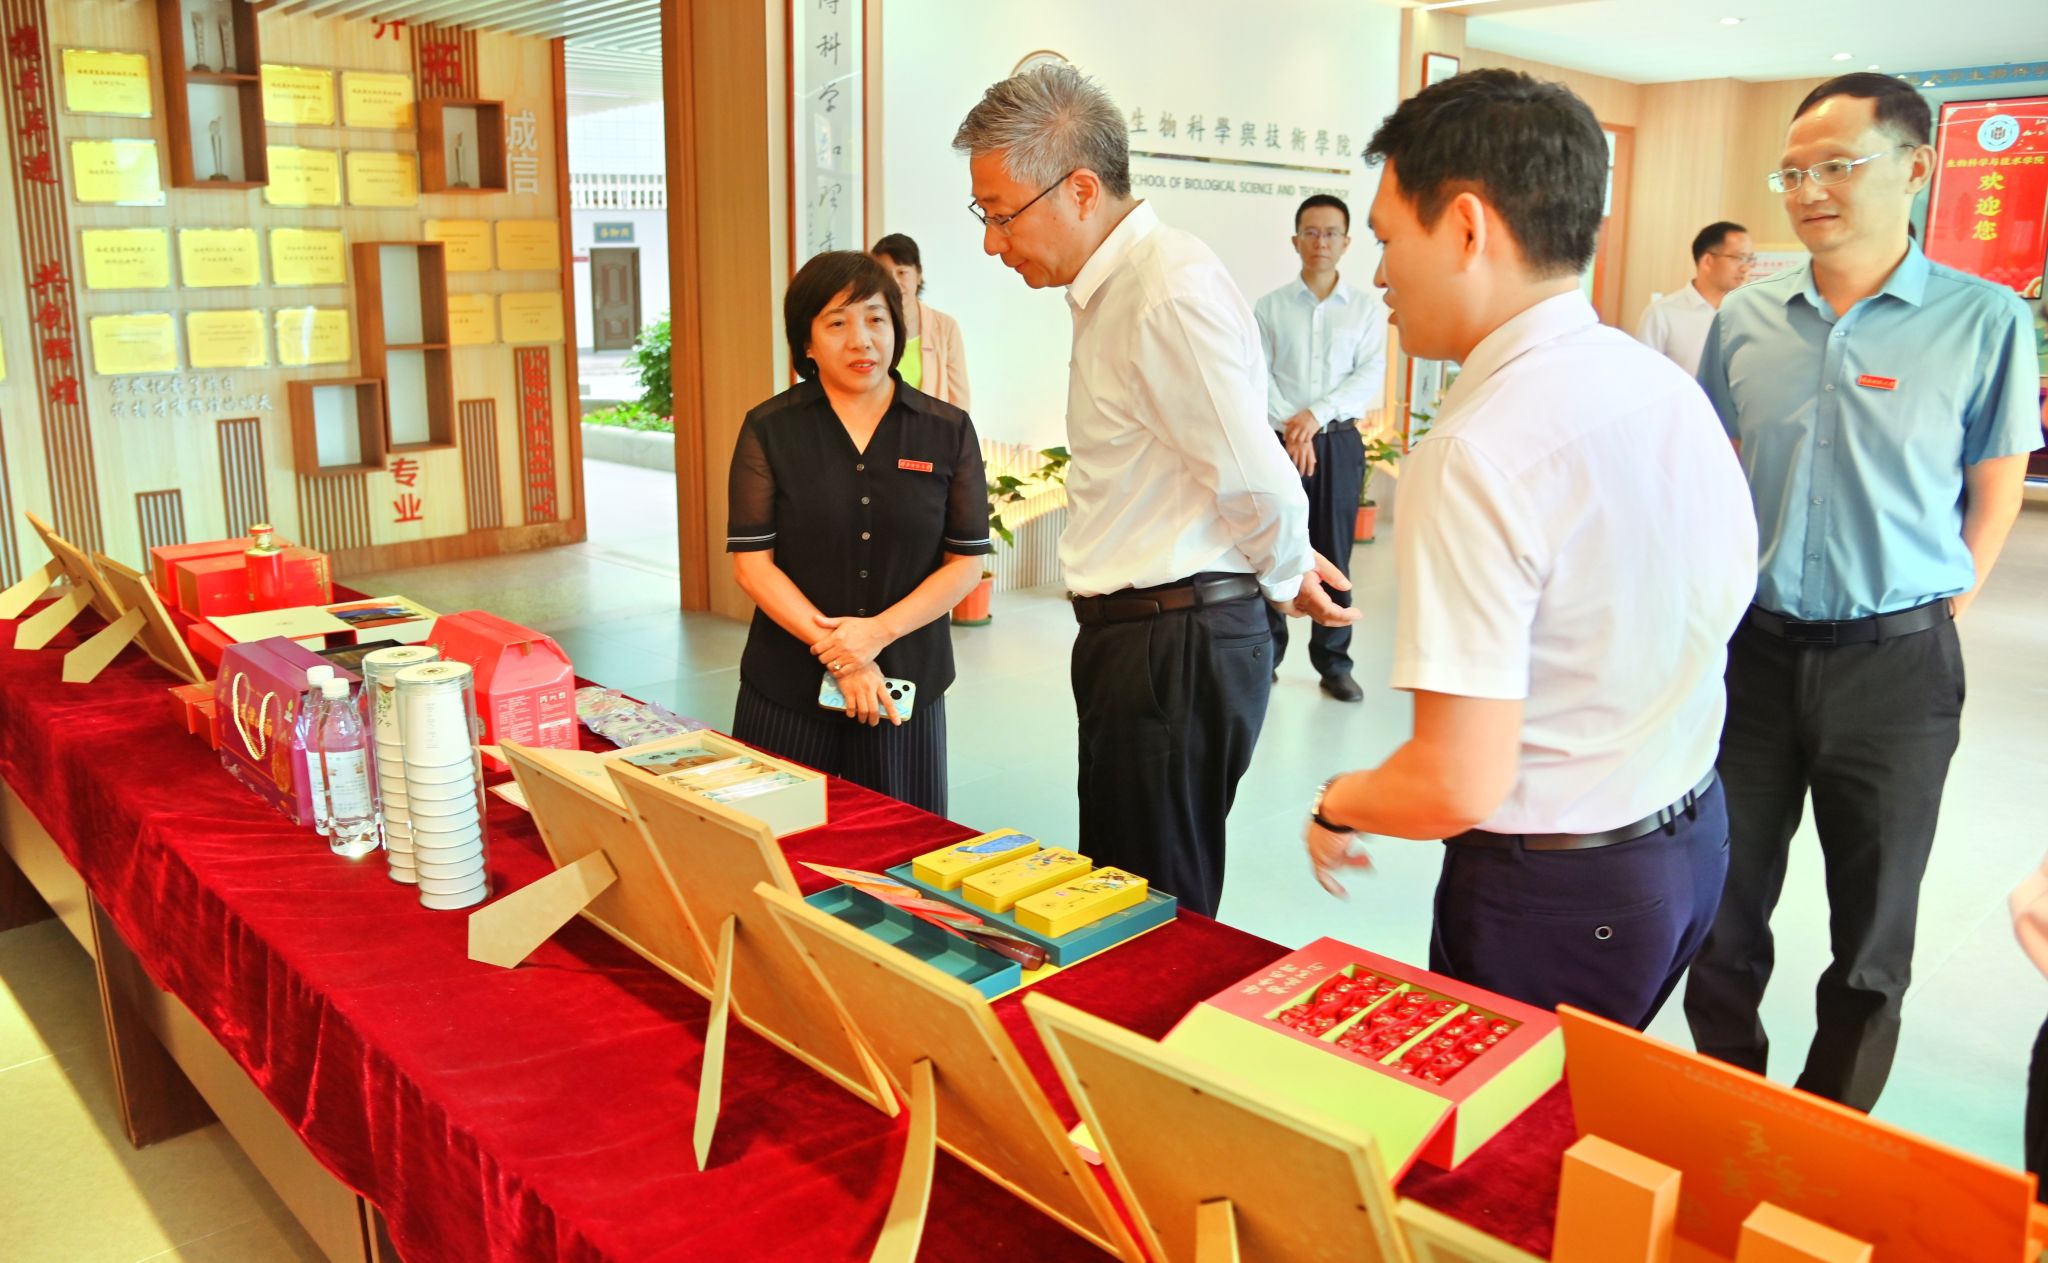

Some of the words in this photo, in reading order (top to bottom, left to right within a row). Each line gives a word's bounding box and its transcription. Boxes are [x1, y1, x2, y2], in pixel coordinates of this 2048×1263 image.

[1946, 155, 2045, 169] 生物科学与技术学院
[1169, 176, 1181, 189] OF
[1184, 177, 1236, 193] BIOLOGICAL
[1239, 181, 1273, 195] SCIENCE
[1277, 183, 1296, 196] AND
[1971, 171, 2005, 241] 欢迎您
[390, 458, 423, 524] 专业
